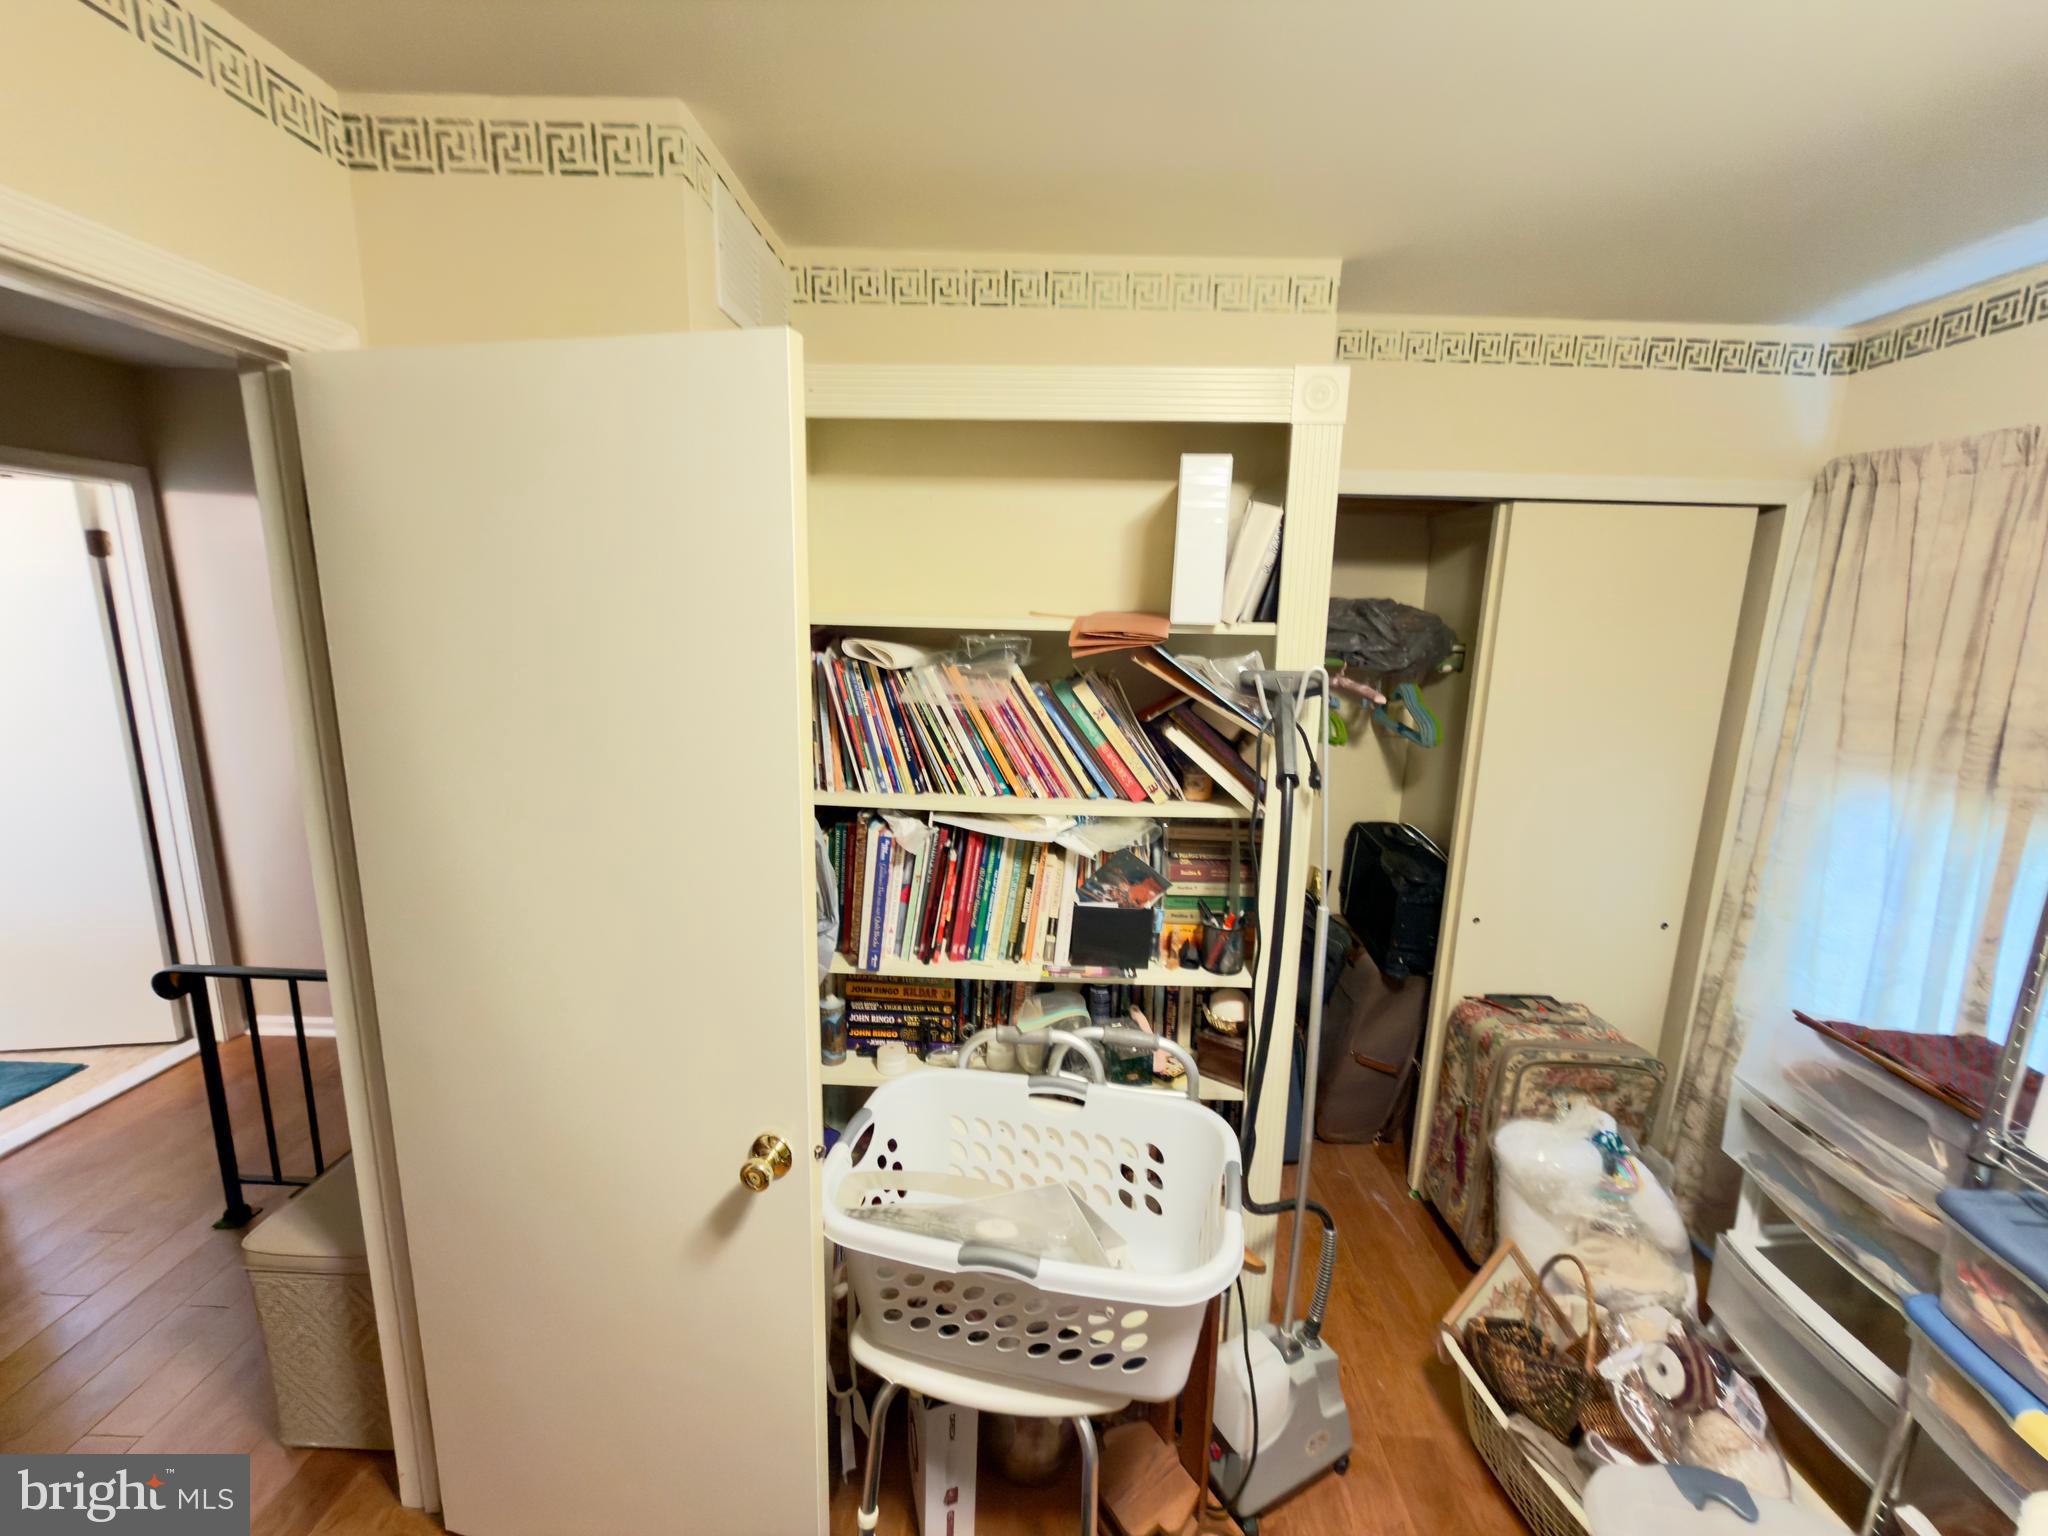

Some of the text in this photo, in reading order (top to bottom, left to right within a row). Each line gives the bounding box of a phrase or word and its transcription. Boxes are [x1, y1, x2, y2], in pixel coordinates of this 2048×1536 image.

[851, 985, 939, 999] JOHN RINGO KILDAR
[849, 1014, 870, 1023] JOHN
[871, 1015, 895, 1024] RINGO
[849, 1029, 871, 1037] JOHN
[872, 1030, 899, 1038] RINGO
